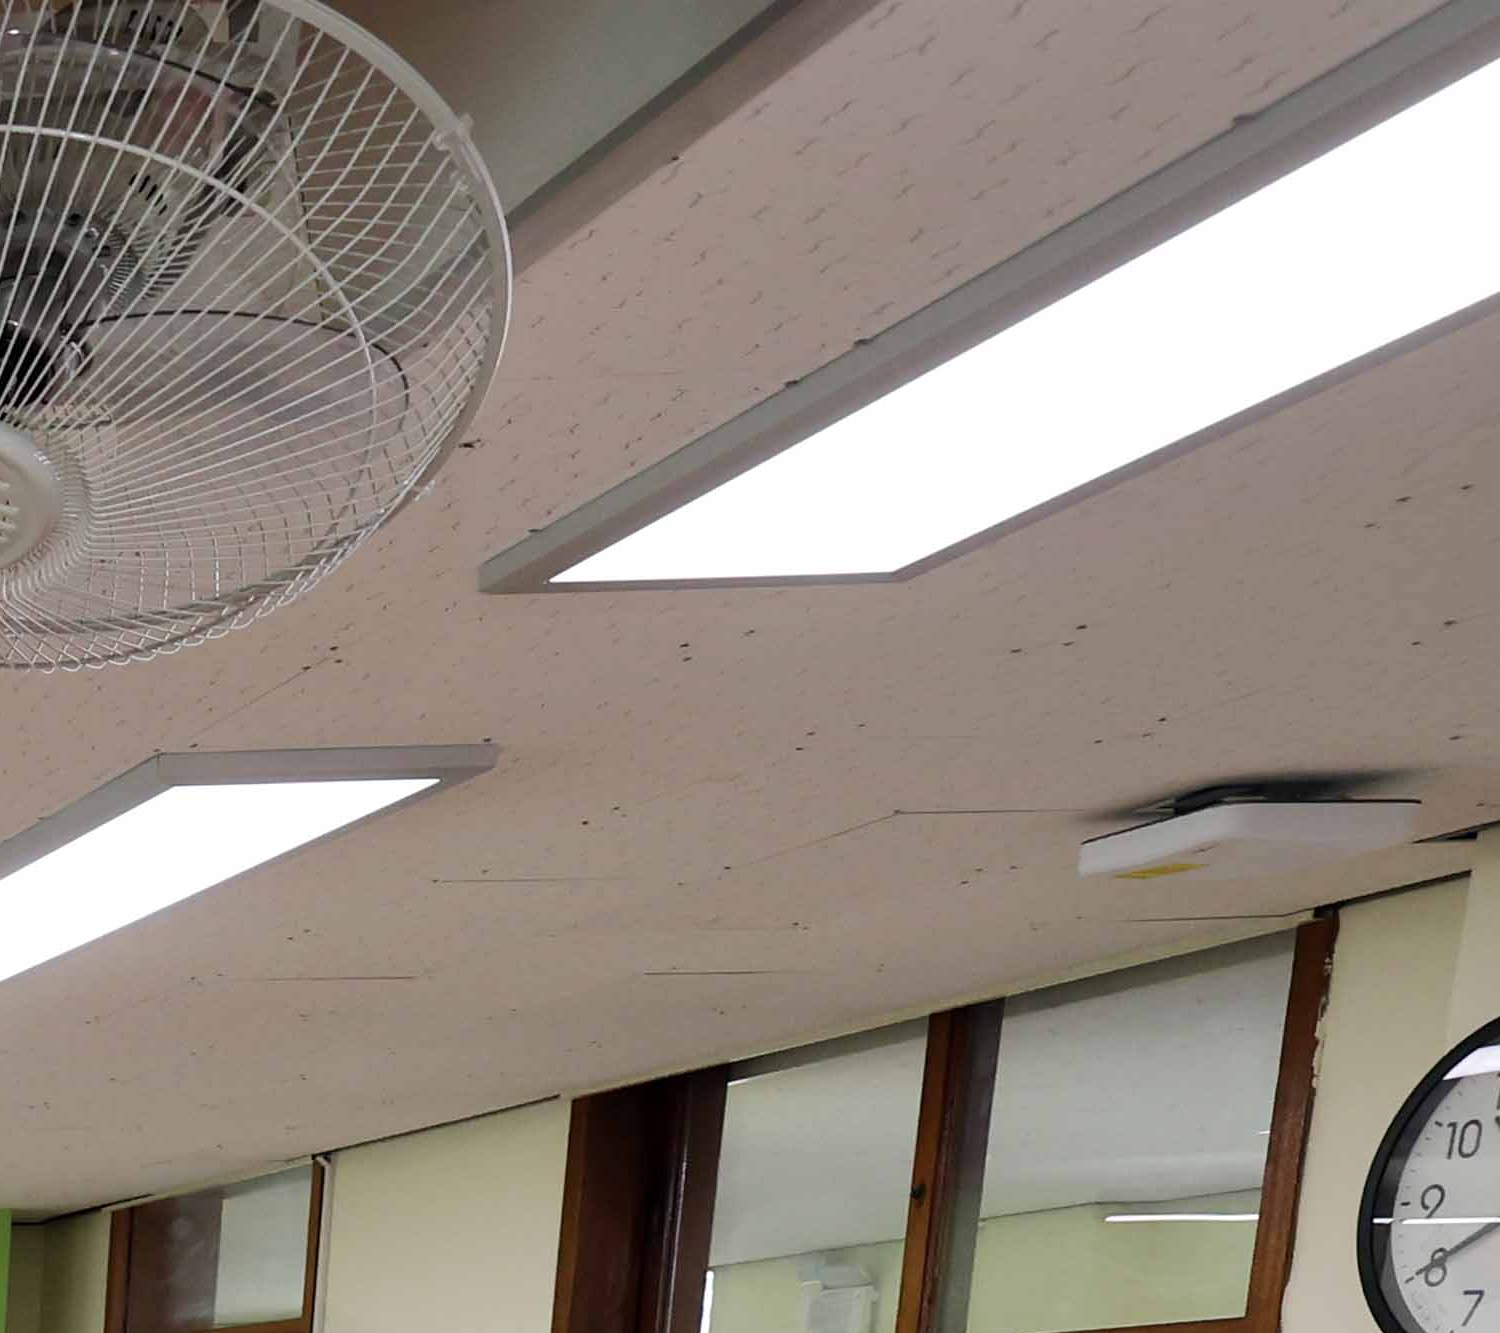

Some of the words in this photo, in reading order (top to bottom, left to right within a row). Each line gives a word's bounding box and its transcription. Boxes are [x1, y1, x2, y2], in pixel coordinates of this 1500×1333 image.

[1446, 1119, 1482, 1160] 10
[1420, 1184, 1446, 1218] 9
[1424, 1248, 1448, 1286] 8
[1462, 1290, 1484, 1326] 7
